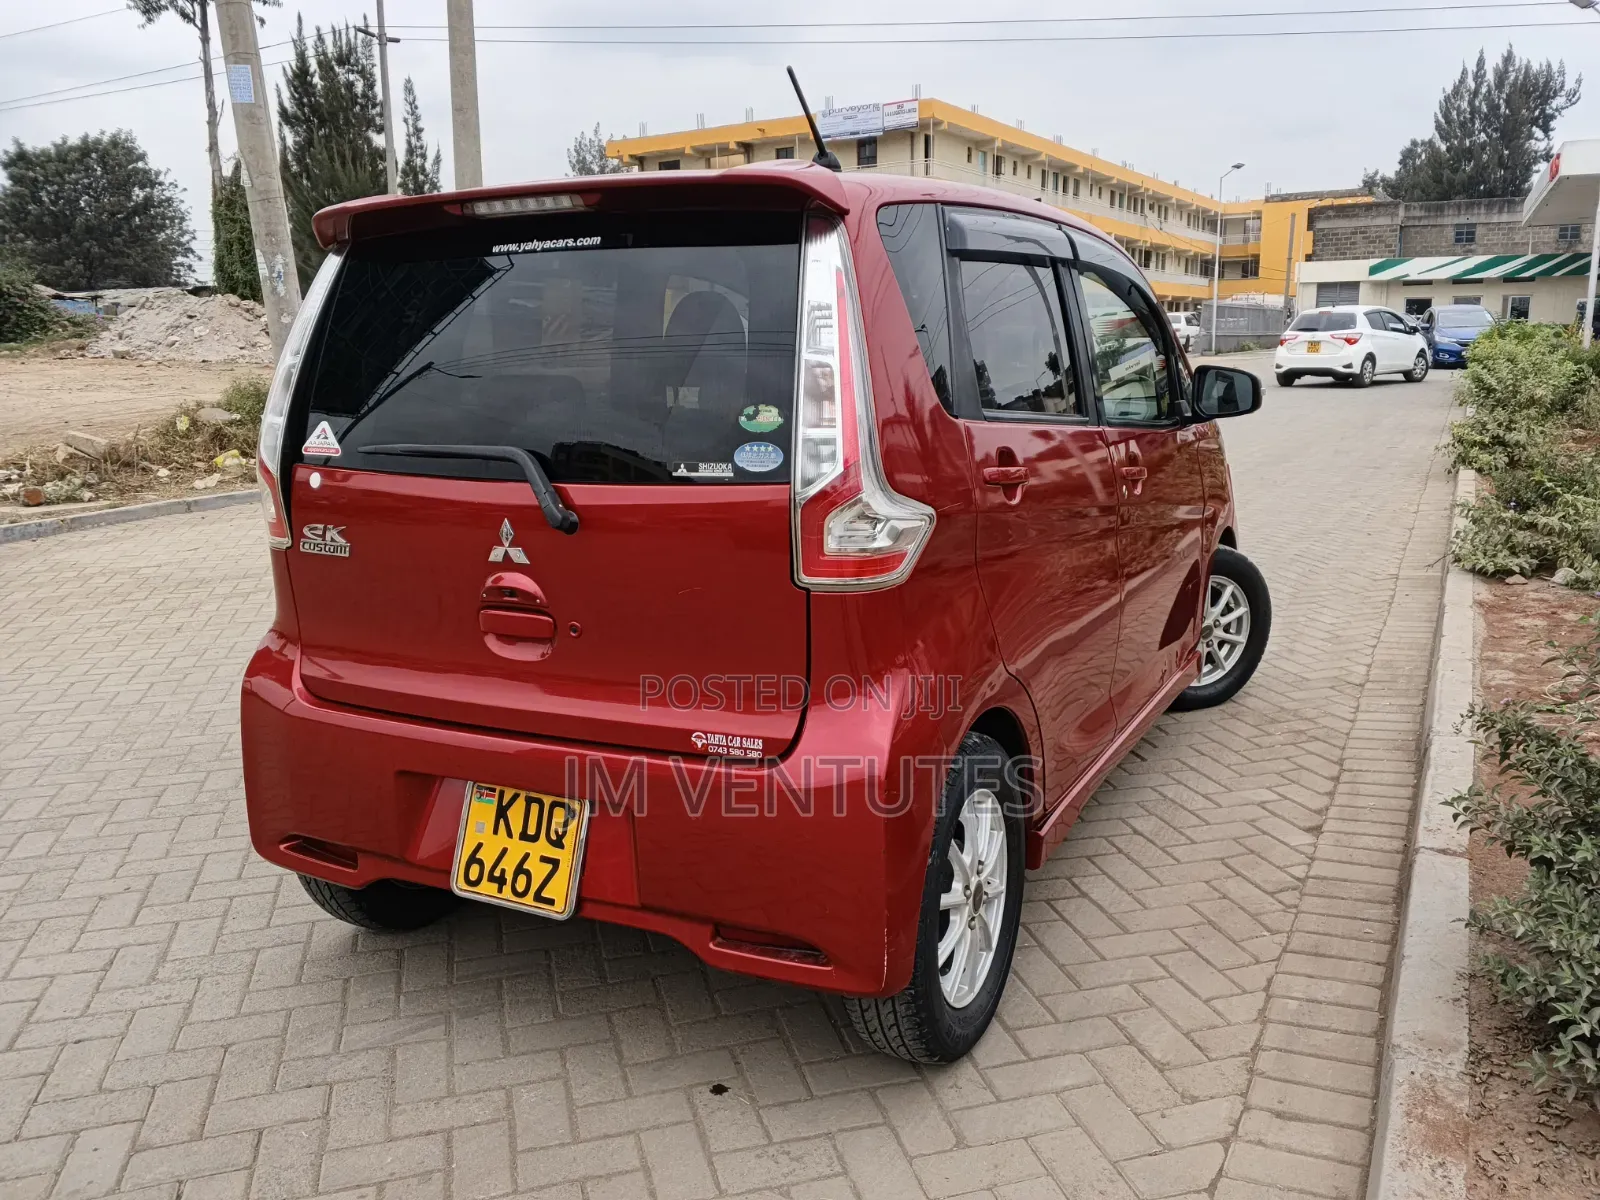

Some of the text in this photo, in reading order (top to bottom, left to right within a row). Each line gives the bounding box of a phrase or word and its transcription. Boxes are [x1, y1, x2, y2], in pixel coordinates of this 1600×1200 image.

[492, 236, 602, 253] www.yahyacars.com
[698, 462, 733, 470] SHIZUOKA
[302, 541, 348, 555] custom
[707, 734, 763, 749] YAHYA CAR SALES
[708, 746, 763, 758] 0743 580 580
[492, 789, 573, 850] KDQ
[463, 841, 561, 907] 646Z
